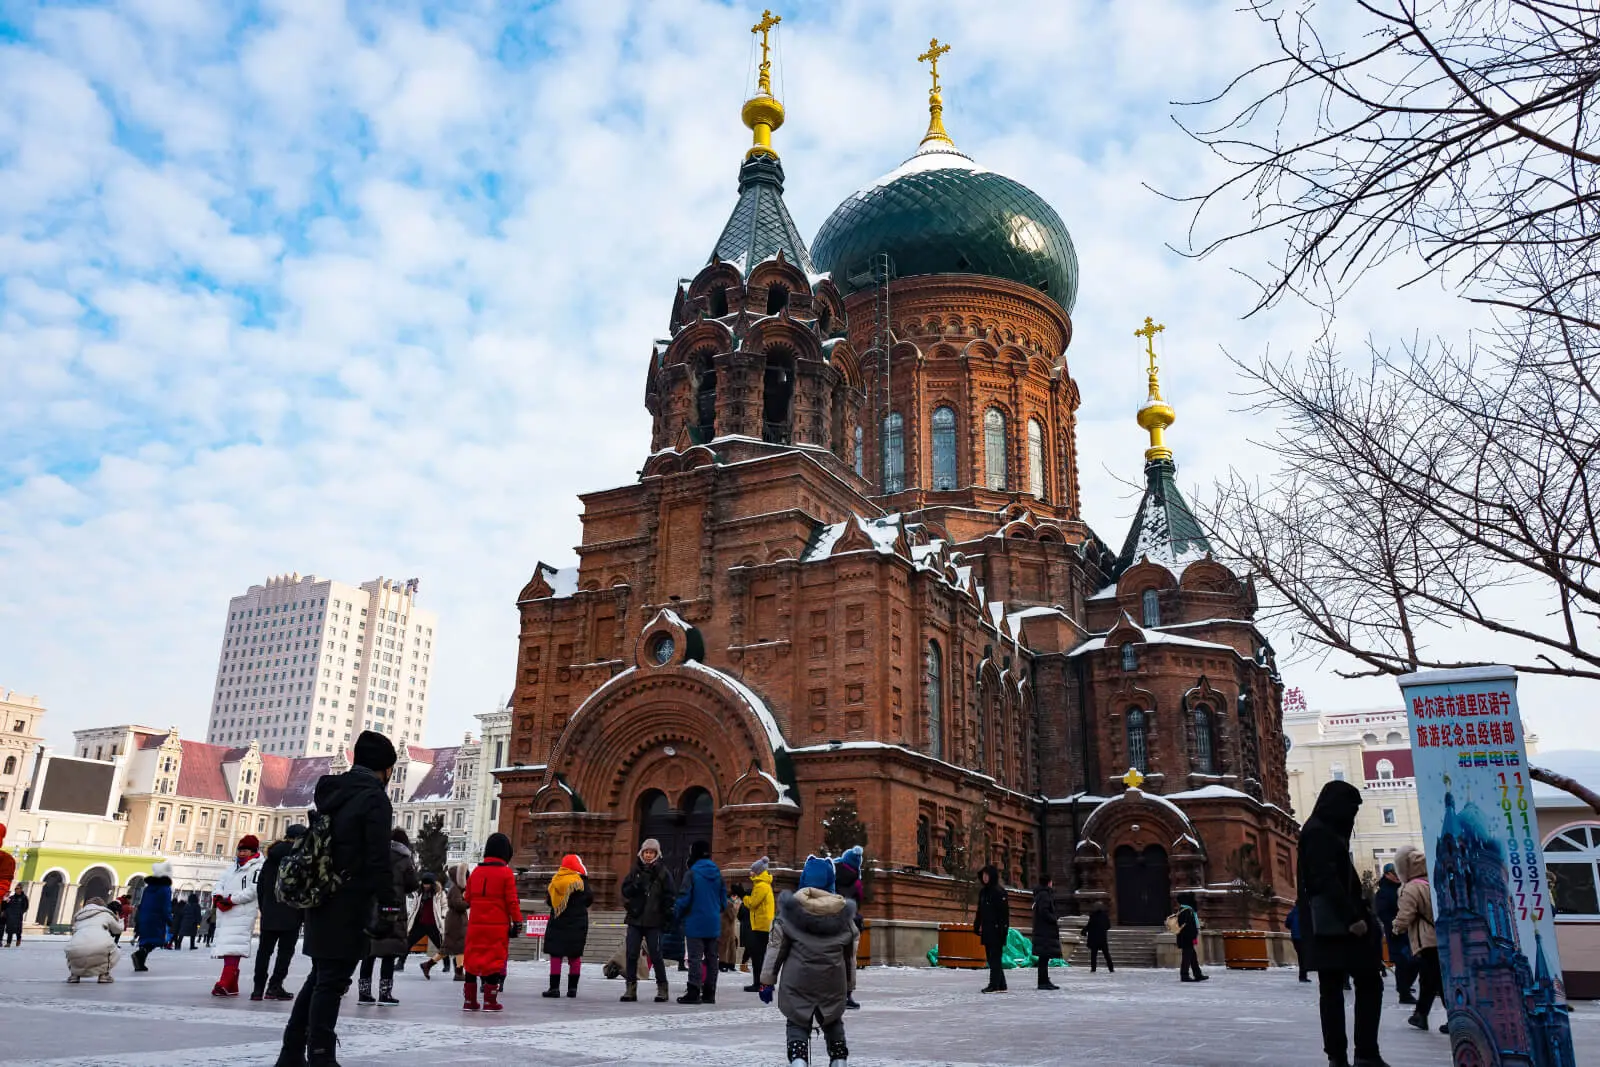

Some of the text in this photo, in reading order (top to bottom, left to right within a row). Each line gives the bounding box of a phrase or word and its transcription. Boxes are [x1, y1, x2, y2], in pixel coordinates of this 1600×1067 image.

[1416, 720, 1515, 748] 旅游纪念品经销部
